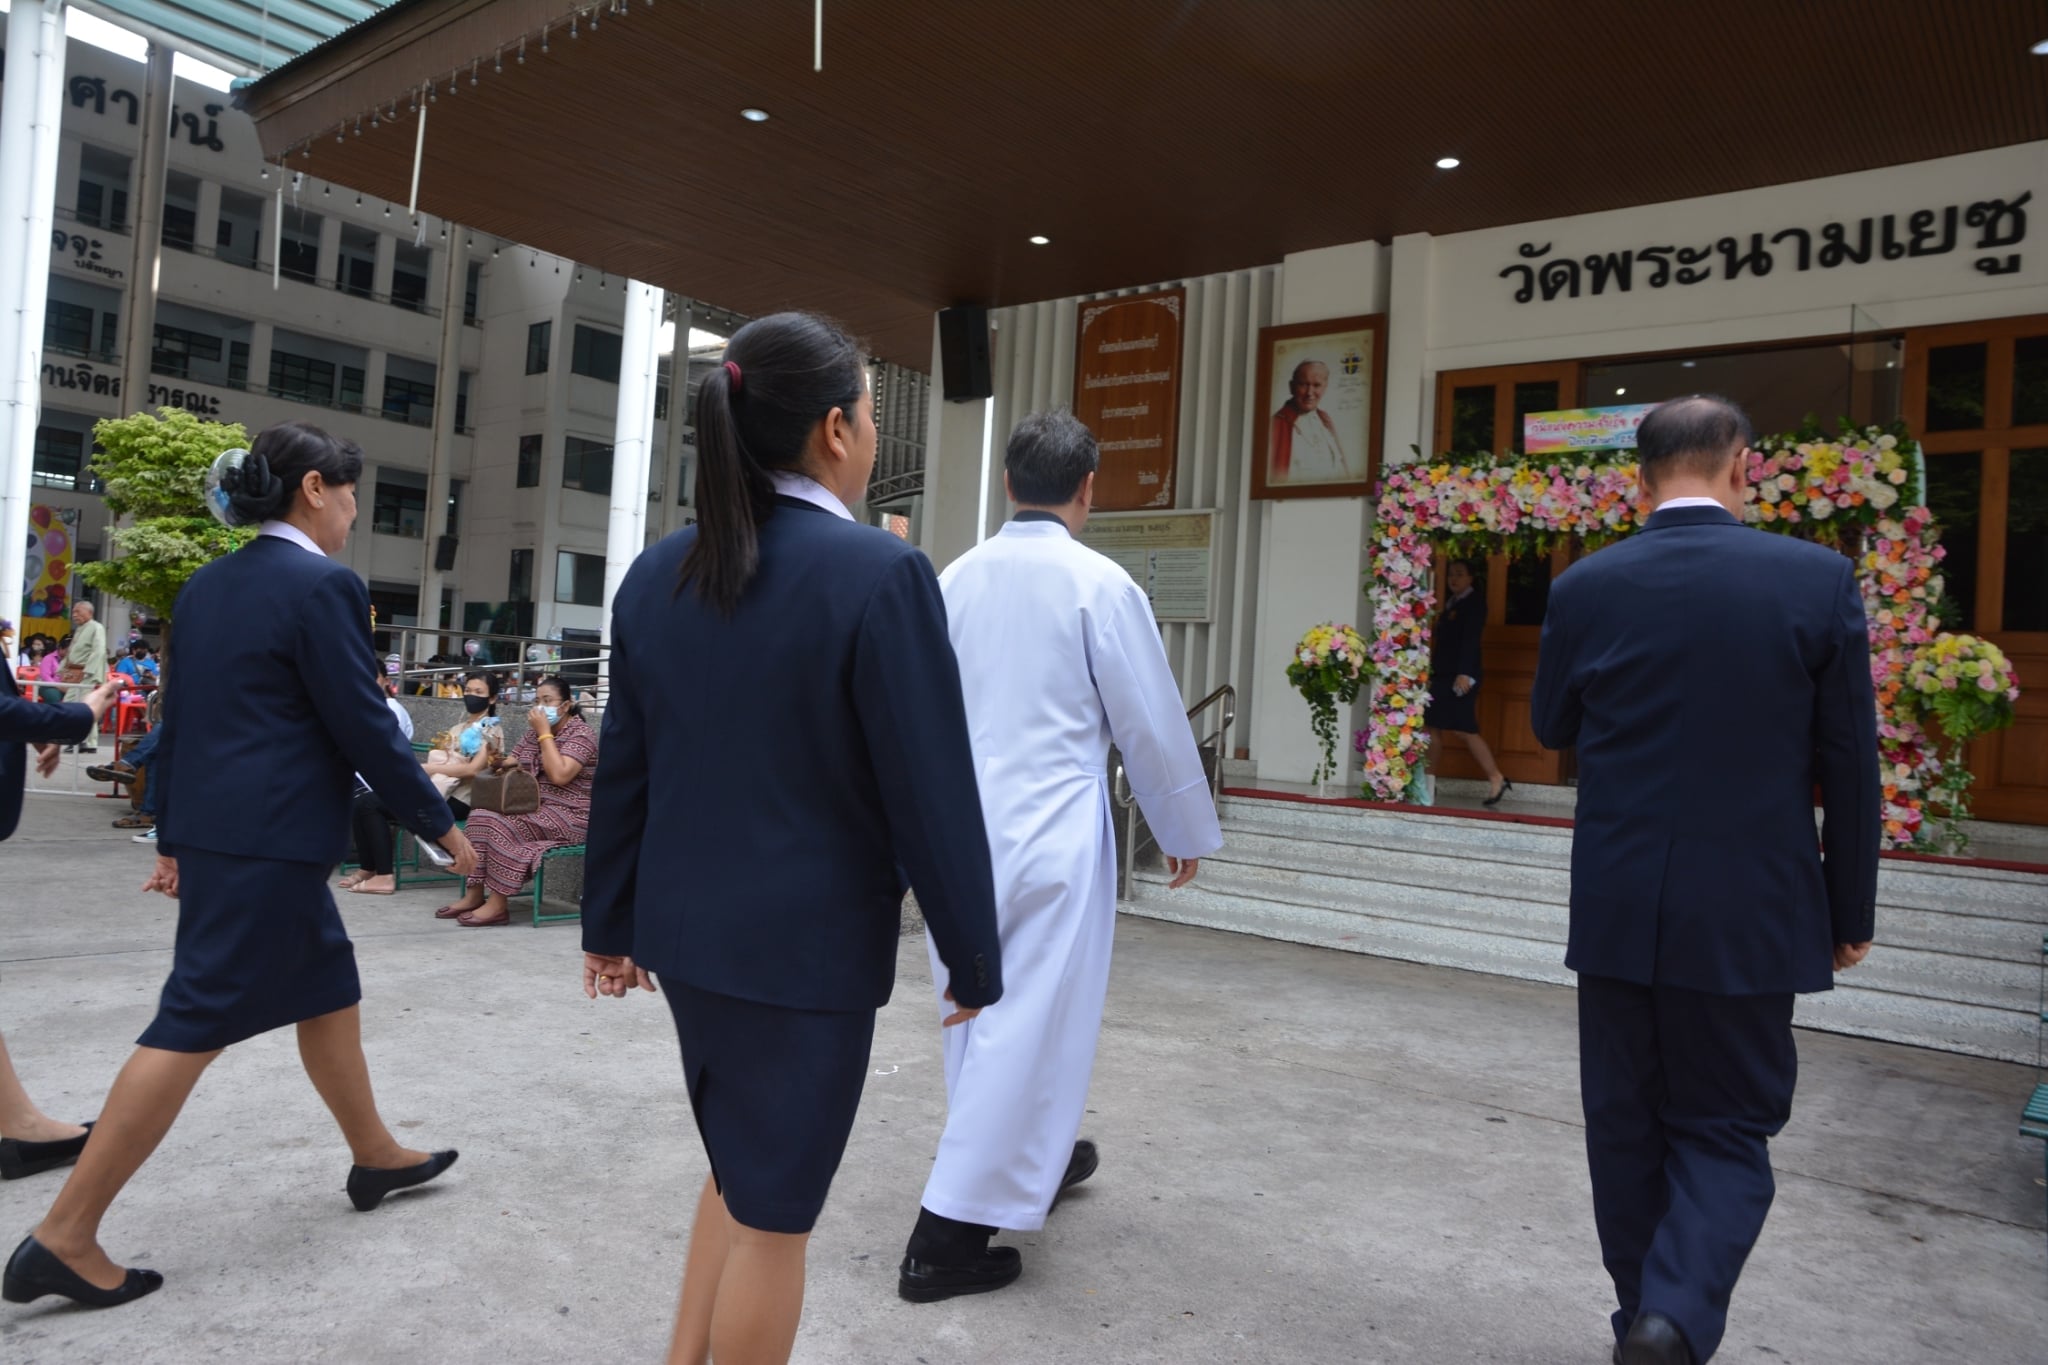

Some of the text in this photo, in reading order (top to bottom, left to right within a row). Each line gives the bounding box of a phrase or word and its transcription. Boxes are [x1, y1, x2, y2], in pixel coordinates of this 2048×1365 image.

[1499, 190, 2033, 304] วัดพระนามเยซู
